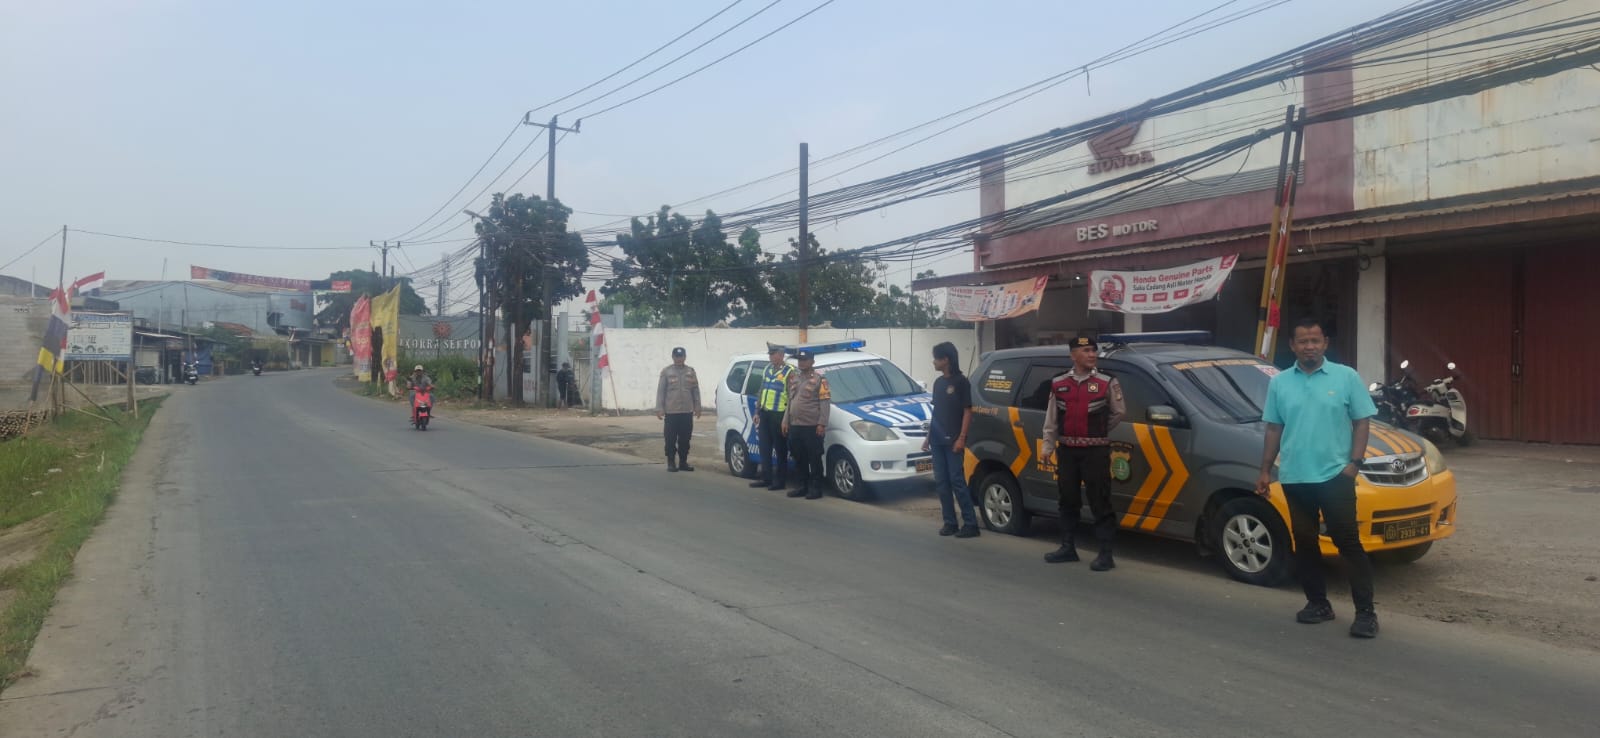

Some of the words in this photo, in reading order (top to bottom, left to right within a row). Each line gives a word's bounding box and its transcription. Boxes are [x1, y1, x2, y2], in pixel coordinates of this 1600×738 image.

[1087, 150, 1154, 174] HONDA
[1076, 223, 1109, 242] BES
[1112, 219, 1159, 237] MOTOR
[1132, 275, 1156, 285] Honda
[1158, 271, 1190, 283] Genuine
[1192, 264, 1213, 277] Parts
